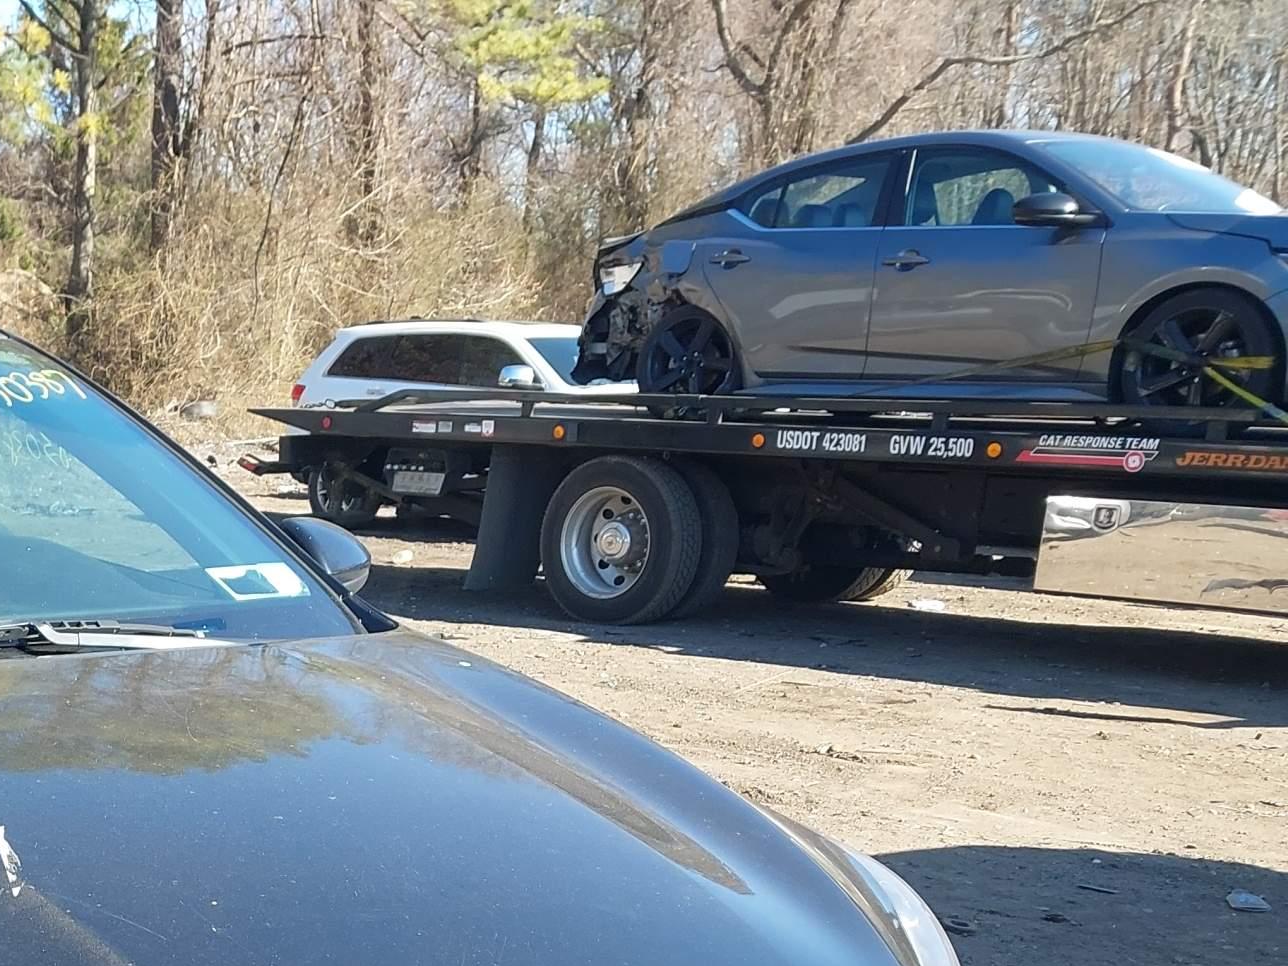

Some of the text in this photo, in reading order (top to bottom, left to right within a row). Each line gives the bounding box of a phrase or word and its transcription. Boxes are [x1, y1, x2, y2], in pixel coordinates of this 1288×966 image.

[777, 430, 867, 452] USDOT 423081
[890, 435, 974, 458] GVW 25,500
[1039, 435, 1160, 449] CAT RESPONSE TEAM
